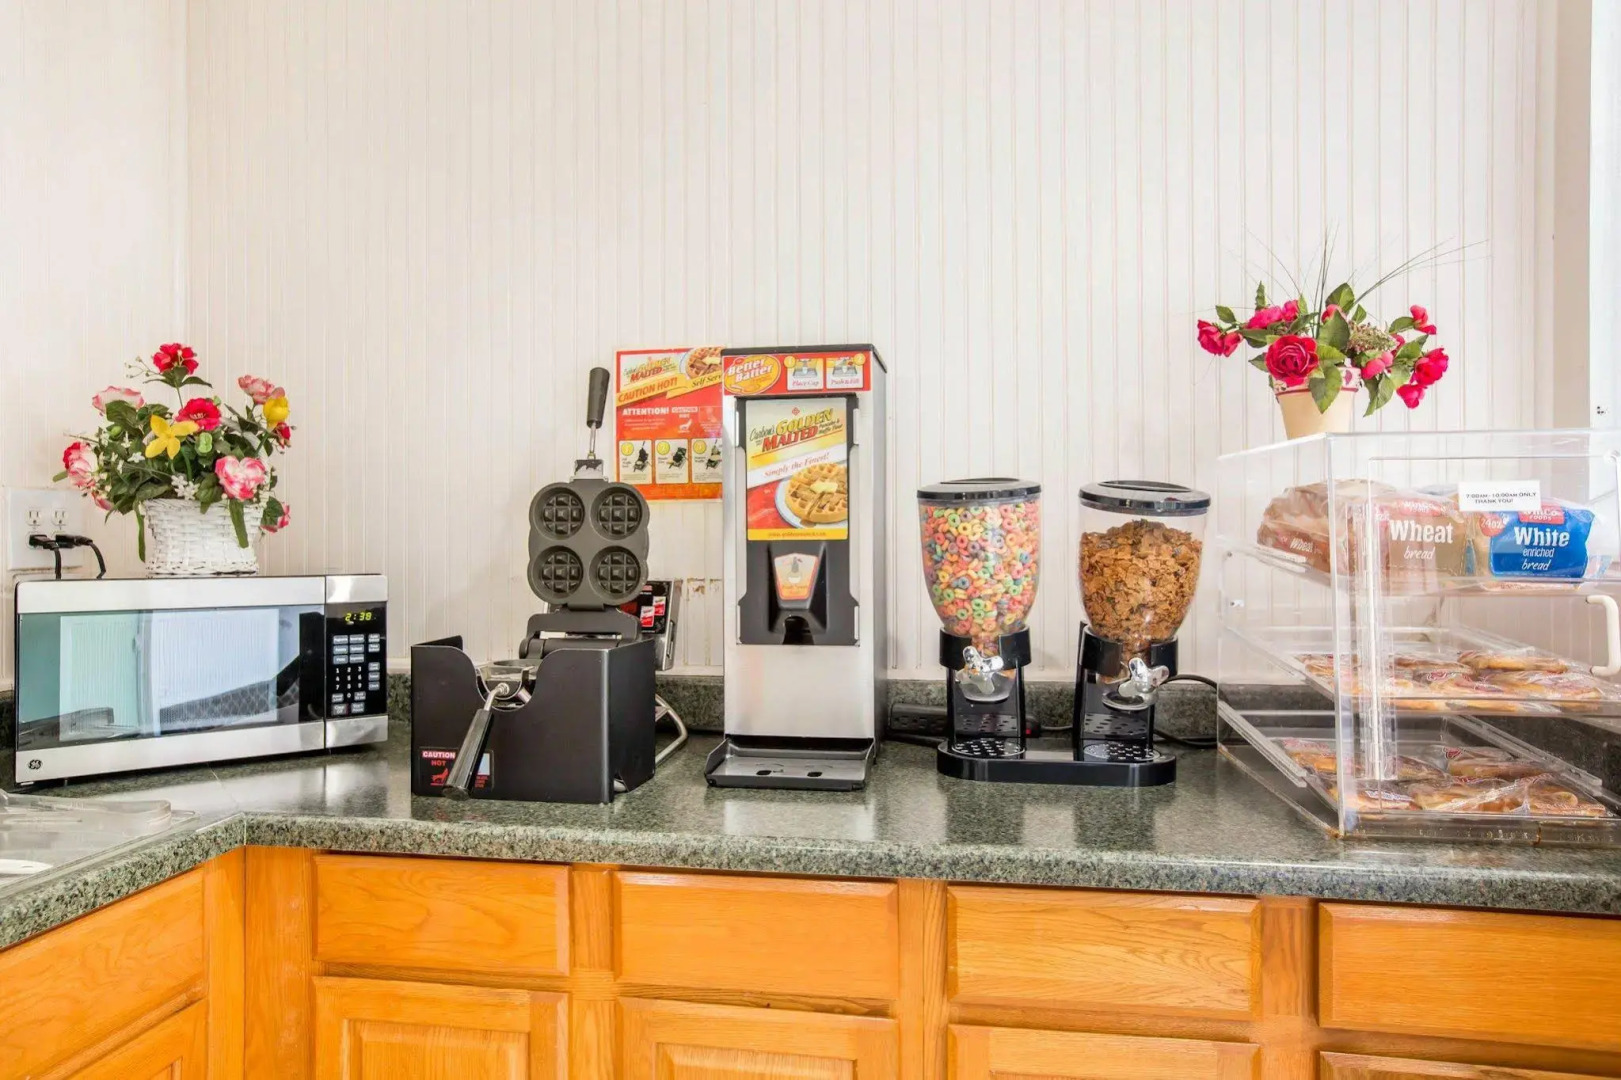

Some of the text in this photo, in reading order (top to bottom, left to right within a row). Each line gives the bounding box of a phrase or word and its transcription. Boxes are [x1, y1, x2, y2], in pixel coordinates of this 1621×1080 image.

[727, 358, 766, 375] Better
[736, 365, 773, 382] Batter
[618, 376, 678, 402] CAUTION HOT!
[692, 377, 706, 388] Self
[622, 407, 669, 415] ATTENTION!
[775, 407, 834, 436] GOLDEN
[762, 425, 819, 452] MALTED
[764, 452, 830, 477] Simply the Finest!
[1388, 520, 1454, 544] Wheat
[1514, 526, 1570, 547] White
[1290, 537, 1313, 552] Wheat
[1403, 546, 1436, 559] bread
[1523, 547, 1554, 558] enriched
[1521, 559, 1552, 571] bread
[345, 611, 372, 622] 2:38
[422, 750, 456, 760] CAUTION
